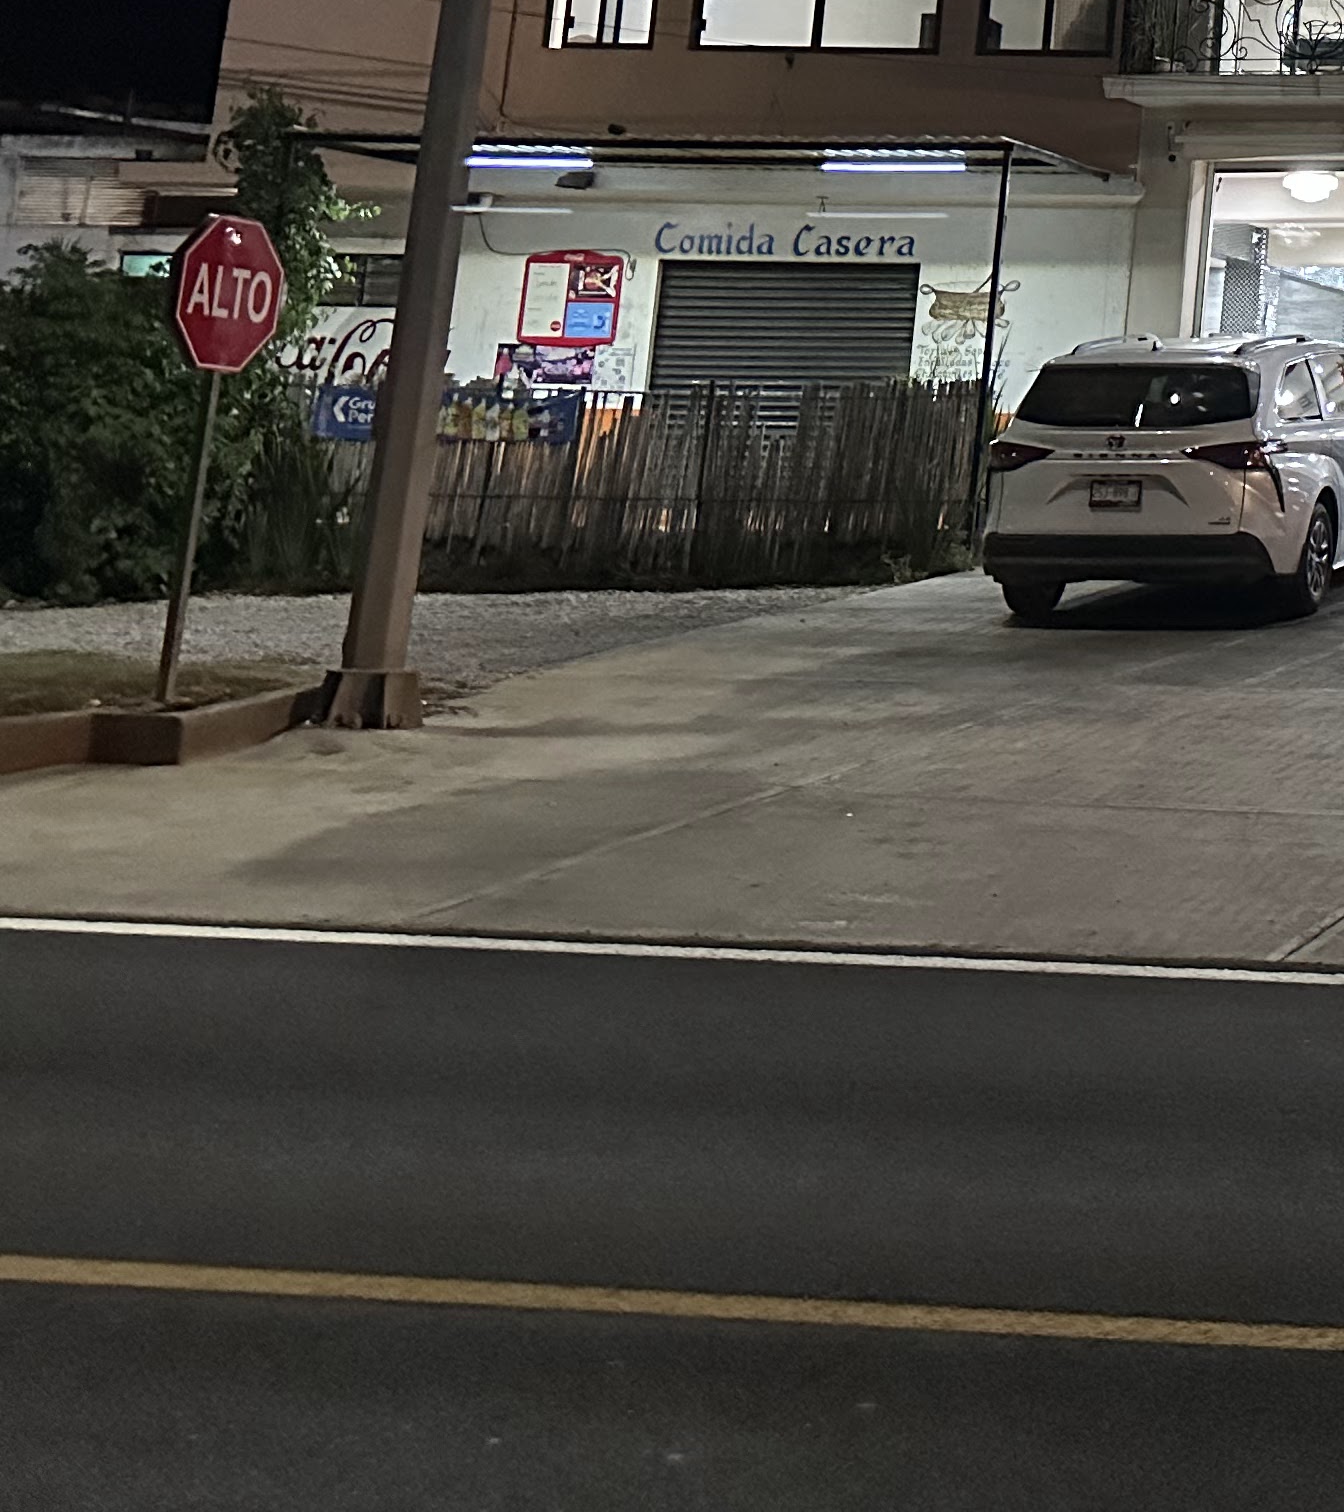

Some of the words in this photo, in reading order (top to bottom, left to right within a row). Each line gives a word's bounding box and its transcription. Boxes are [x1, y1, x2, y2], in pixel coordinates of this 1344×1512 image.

[654, 221, 775, 256] Comida
[793, 223, 915, 257] Casera
[186, 262, 272, 323] ALTO
[348, 396, 376, 410] Gru
